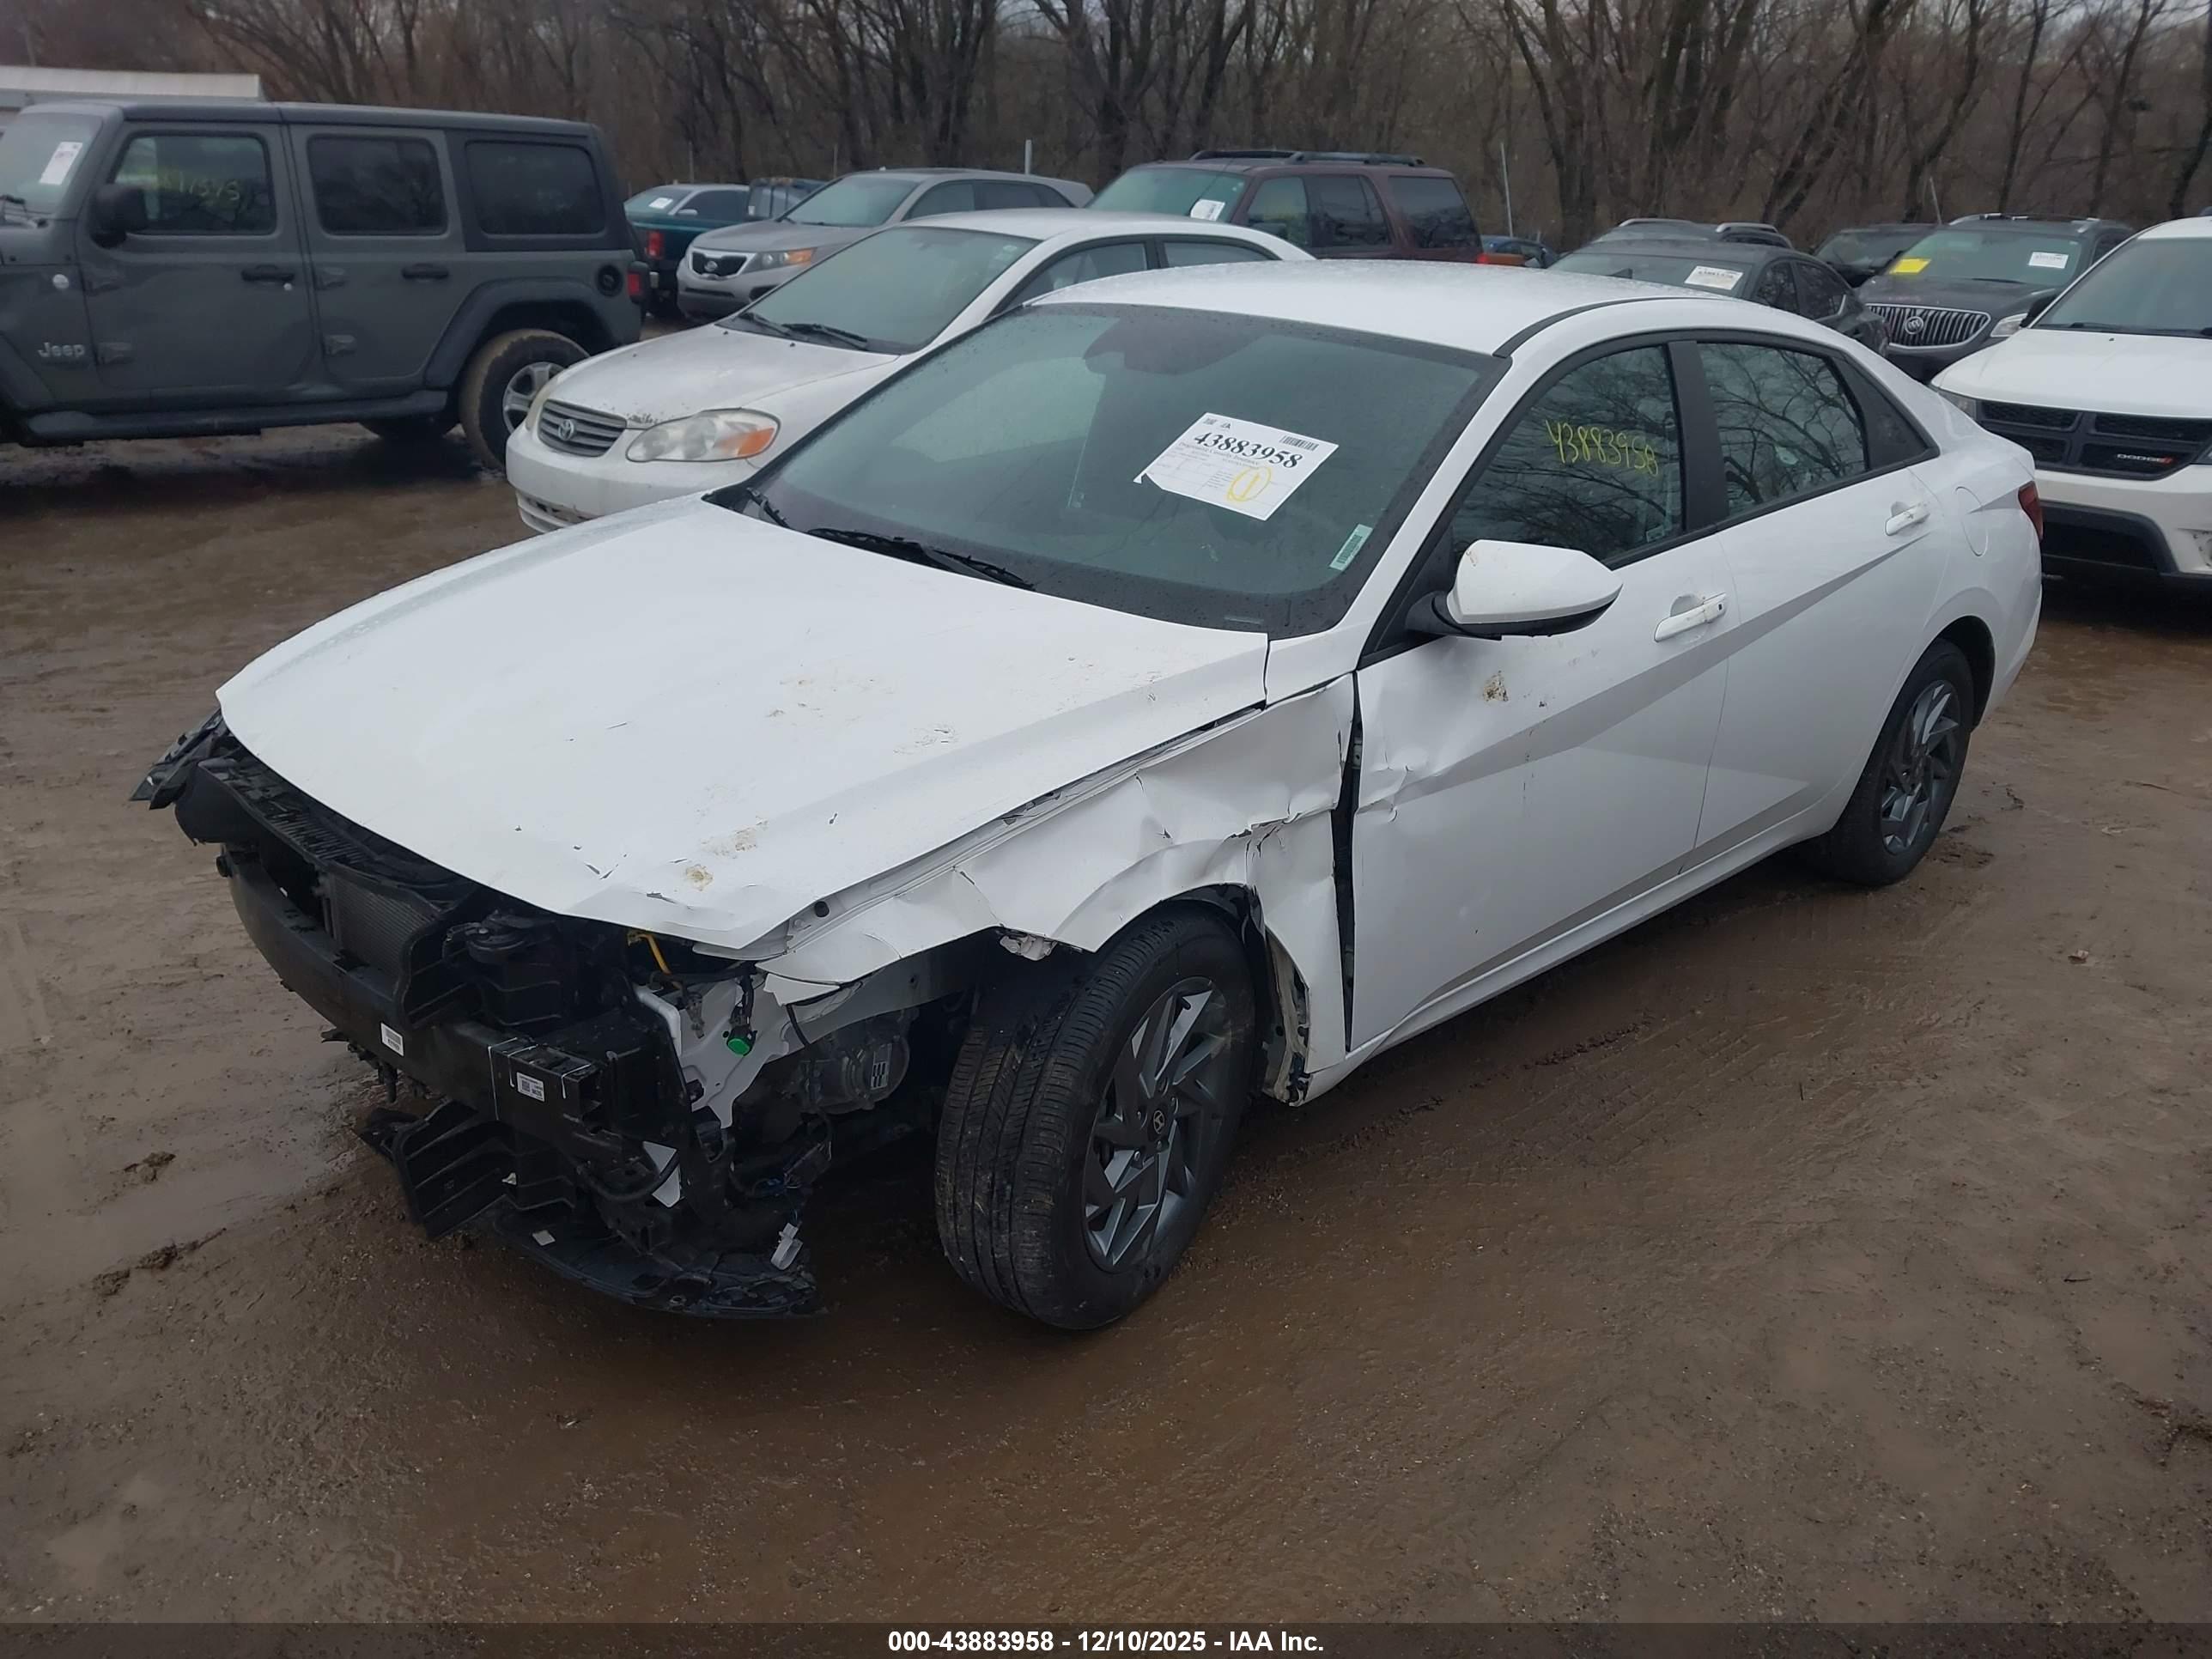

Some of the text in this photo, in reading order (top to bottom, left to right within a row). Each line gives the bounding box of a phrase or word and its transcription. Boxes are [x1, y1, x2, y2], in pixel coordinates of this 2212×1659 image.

[37, 342, 85, 358] Jeep
[1194, 432, 1304, 468] 43883958
[1545, 419, 1659, 477] 43883958
[2117, 453, 2164, 464] DODGE
